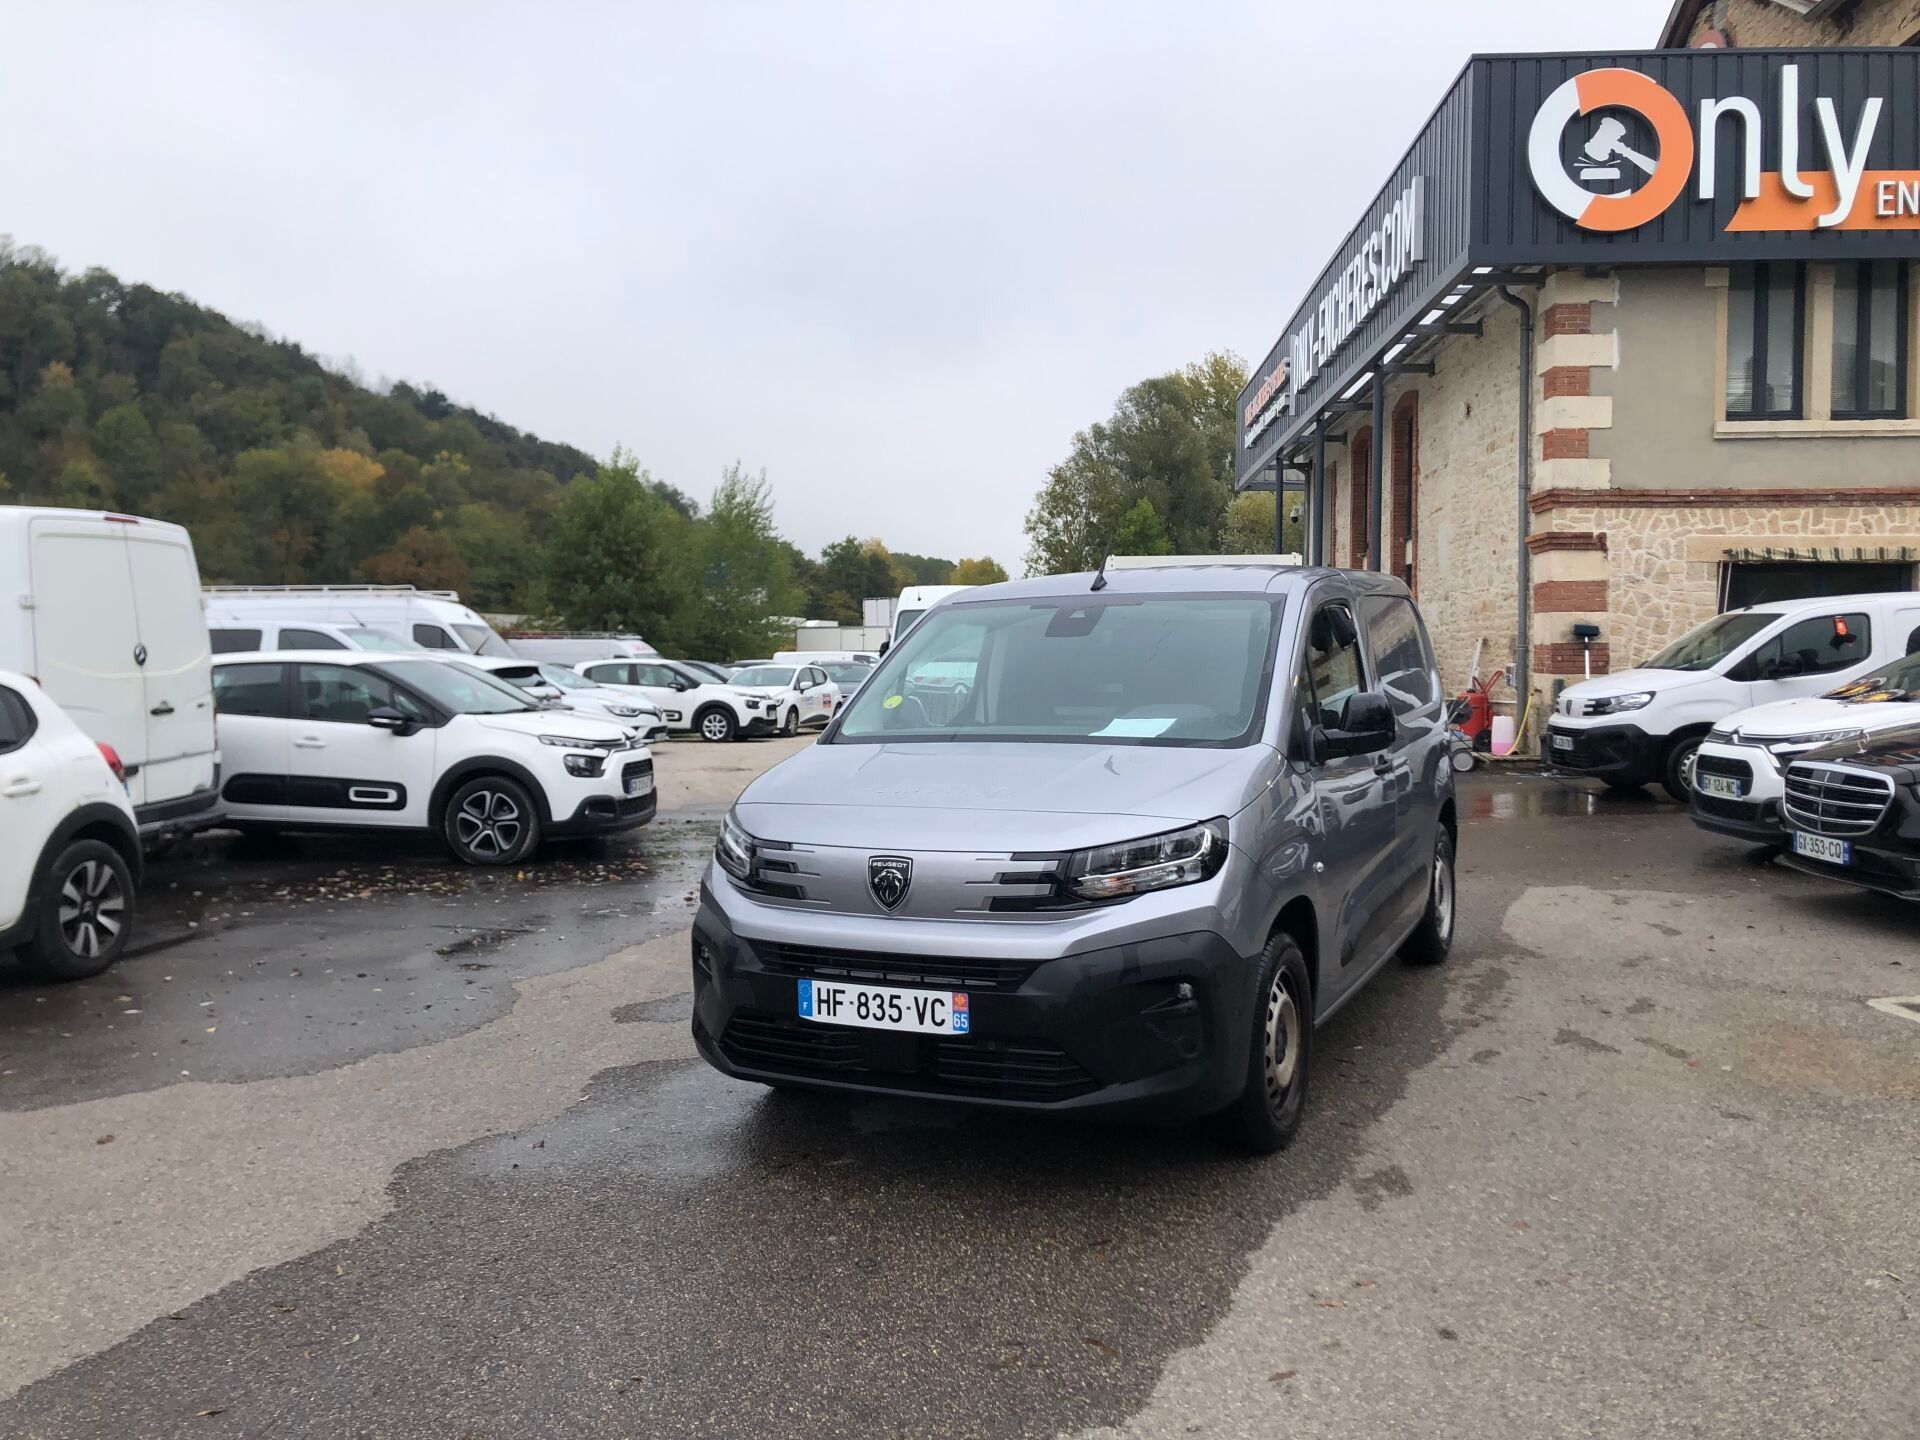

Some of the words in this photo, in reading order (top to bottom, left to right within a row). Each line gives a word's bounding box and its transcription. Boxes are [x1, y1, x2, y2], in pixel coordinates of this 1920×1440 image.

[1528, 64, 1883, 231] Only
[1878, 180, 1919, 215] EN
[1293, 175, 1422, 396] ONLY-ENCHERES.COM
[1799, 834, 1842, 859] GX-353-CQ
[816, 986, 946, 1028] HF-835-VC
[953, 1013, 968, 1028] 65
